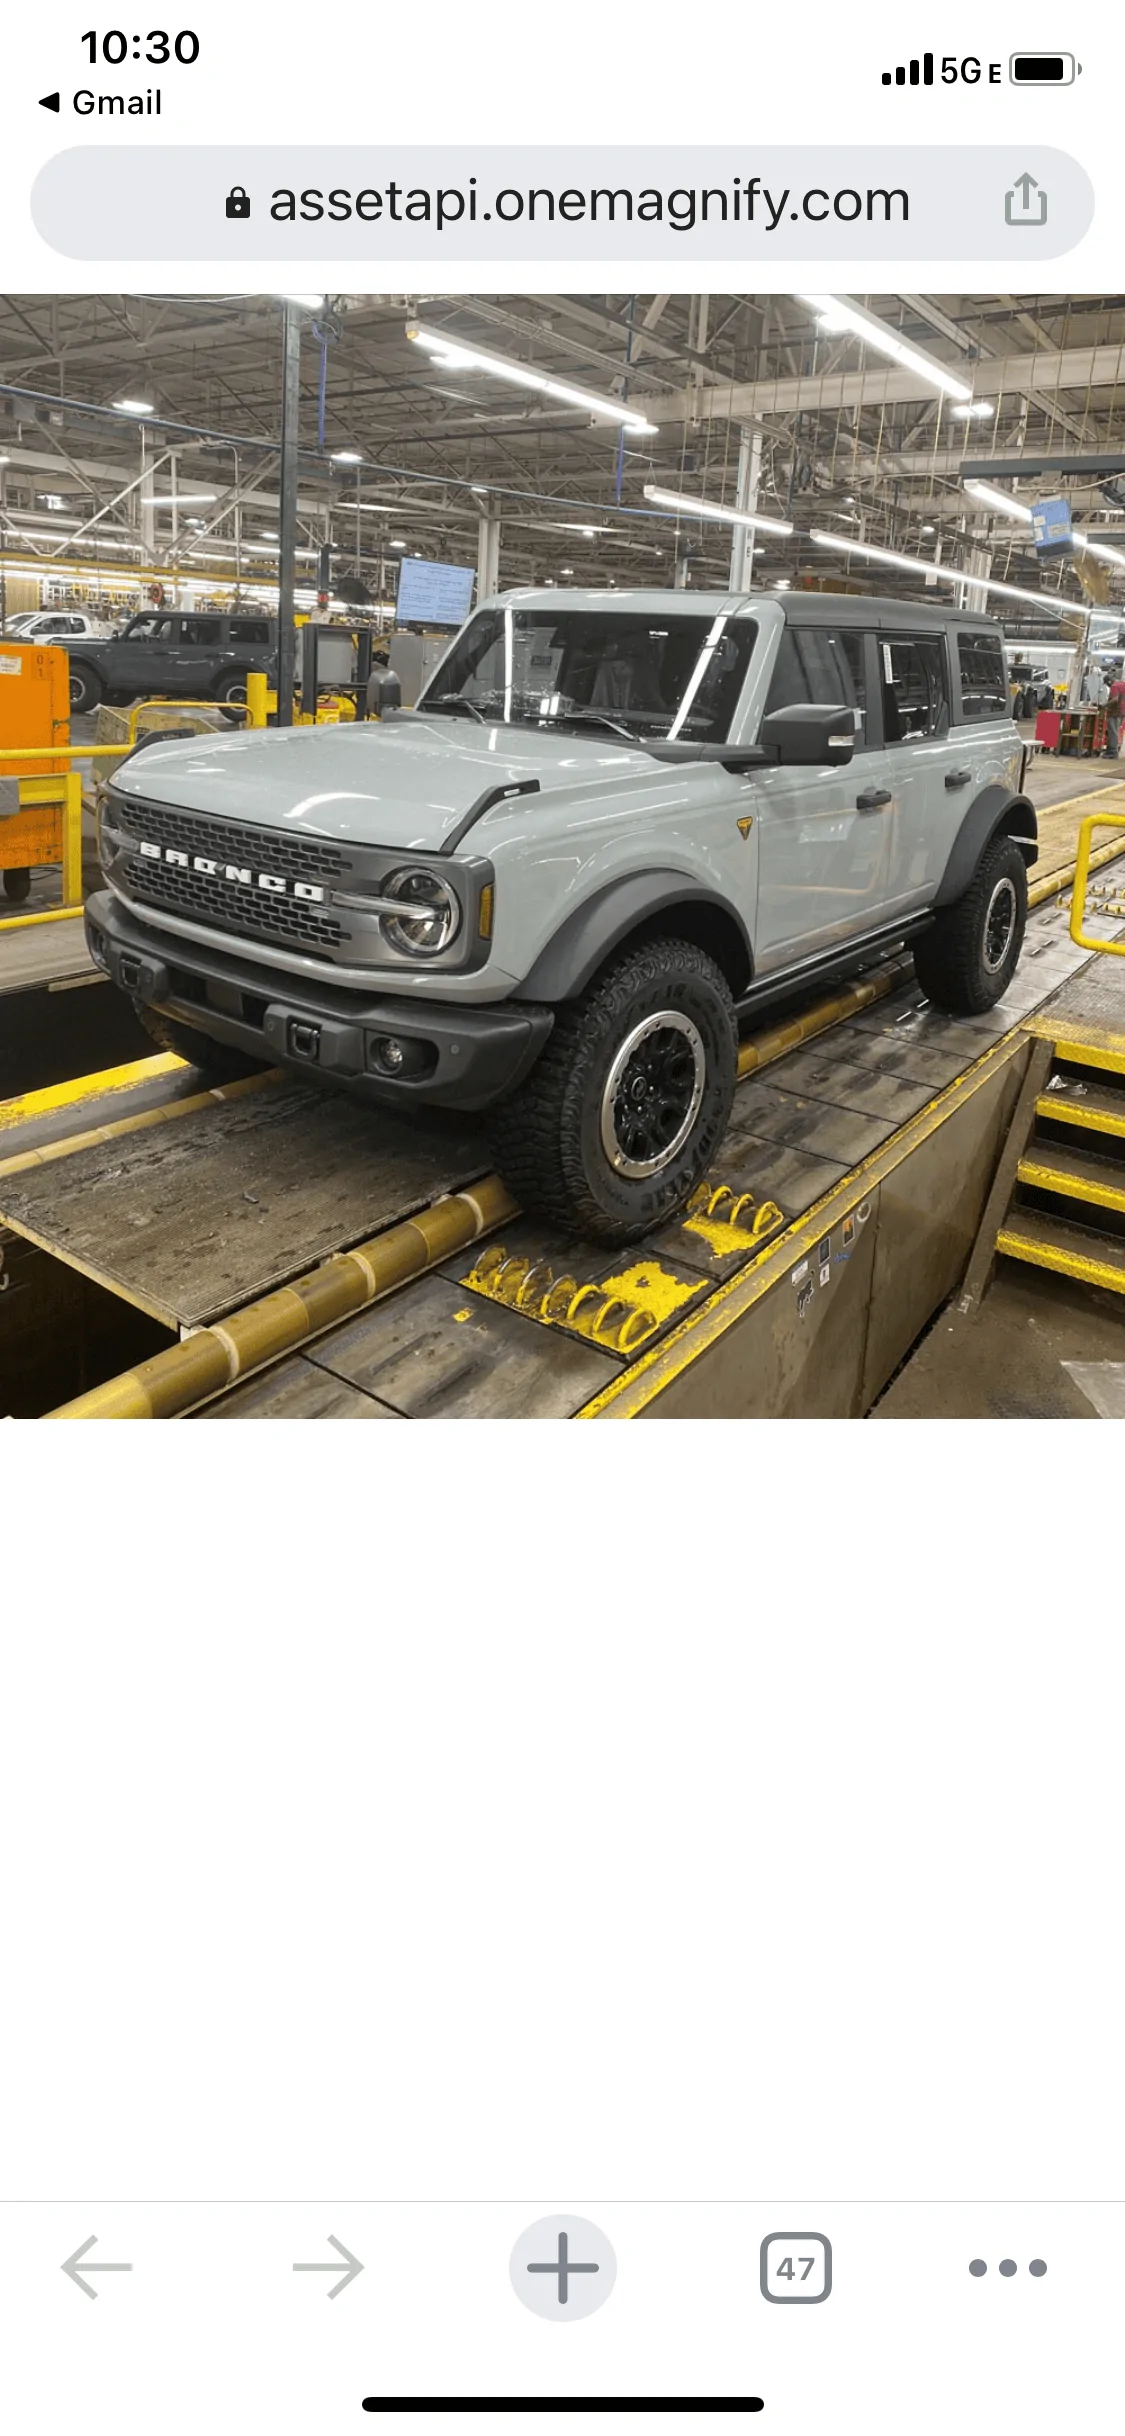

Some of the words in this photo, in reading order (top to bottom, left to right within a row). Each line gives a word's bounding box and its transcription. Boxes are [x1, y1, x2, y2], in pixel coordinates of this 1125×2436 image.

[81, 29, 200, 65] 10:30
[72, 88, 161, 116] Gmail
[270, 177, 909, 232] assetapi.onemagnify.com
[140, 841, 324, 902] BRONCO
[776, 2257, 815, 2281] 47
